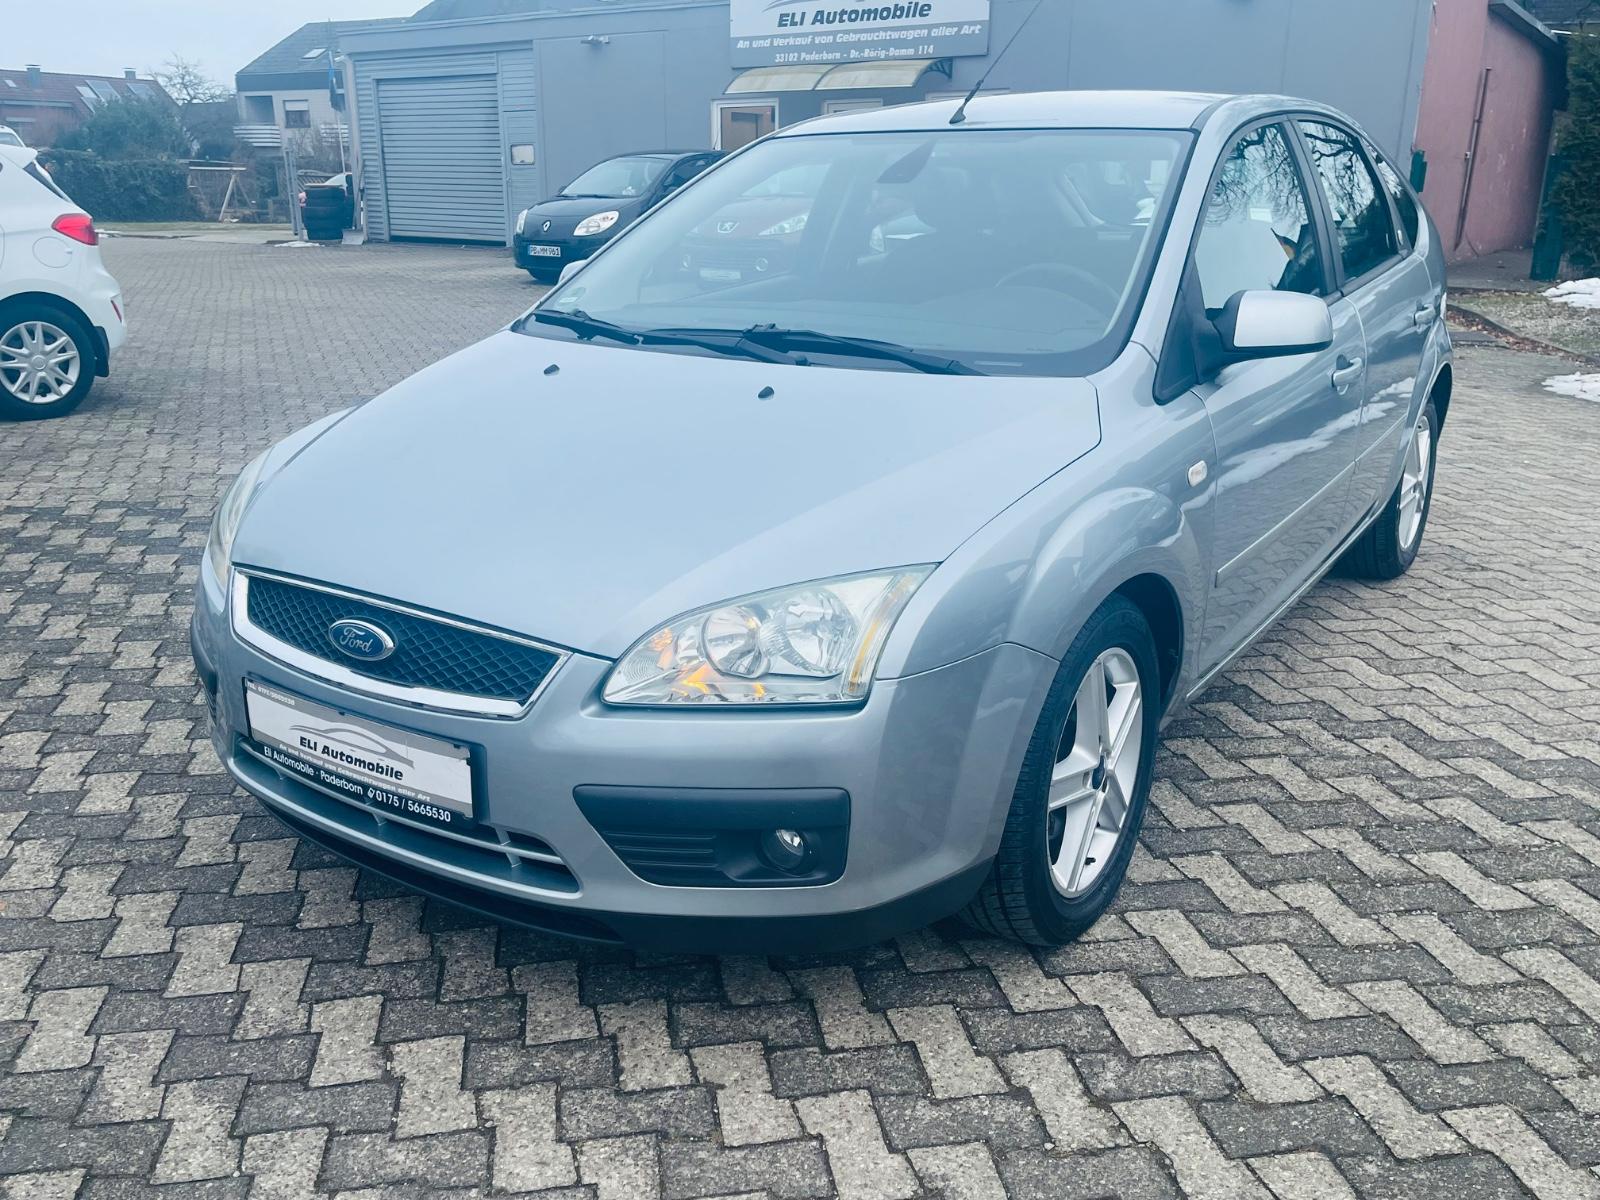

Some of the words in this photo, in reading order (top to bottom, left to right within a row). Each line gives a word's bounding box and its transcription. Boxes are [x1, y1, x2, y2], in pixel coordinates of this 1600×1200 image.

[777, 11, 807, 28] ELI
[811, 1, 932, 25] Automobile
[736, 40, 750, 48] An
[752, 39, 770, 47] und
[773, 35, 813, 46] Verkauf
[814, 35, 833, 43] von
[836, 28, 928, 42] Gebrauchtwagen
[931, 26, 958, 37] aller
[960, 24, 982, 34] Art
[775, 53, 798, 62] 33102
[801, 50, 841, 61] Paderborn
[919, 45, 934, 55] 114
[340, 627, 374, 653] Ford
[300, 736, 318, 752] ELI
[321, 745, 404, 781] Automobile
[273, 751, 315, 776] Automobile
[320, 770, 363, 795] Paderborn
[375, 790, 400, 807] 0175
[407, 800, 451, 822] 5665530
